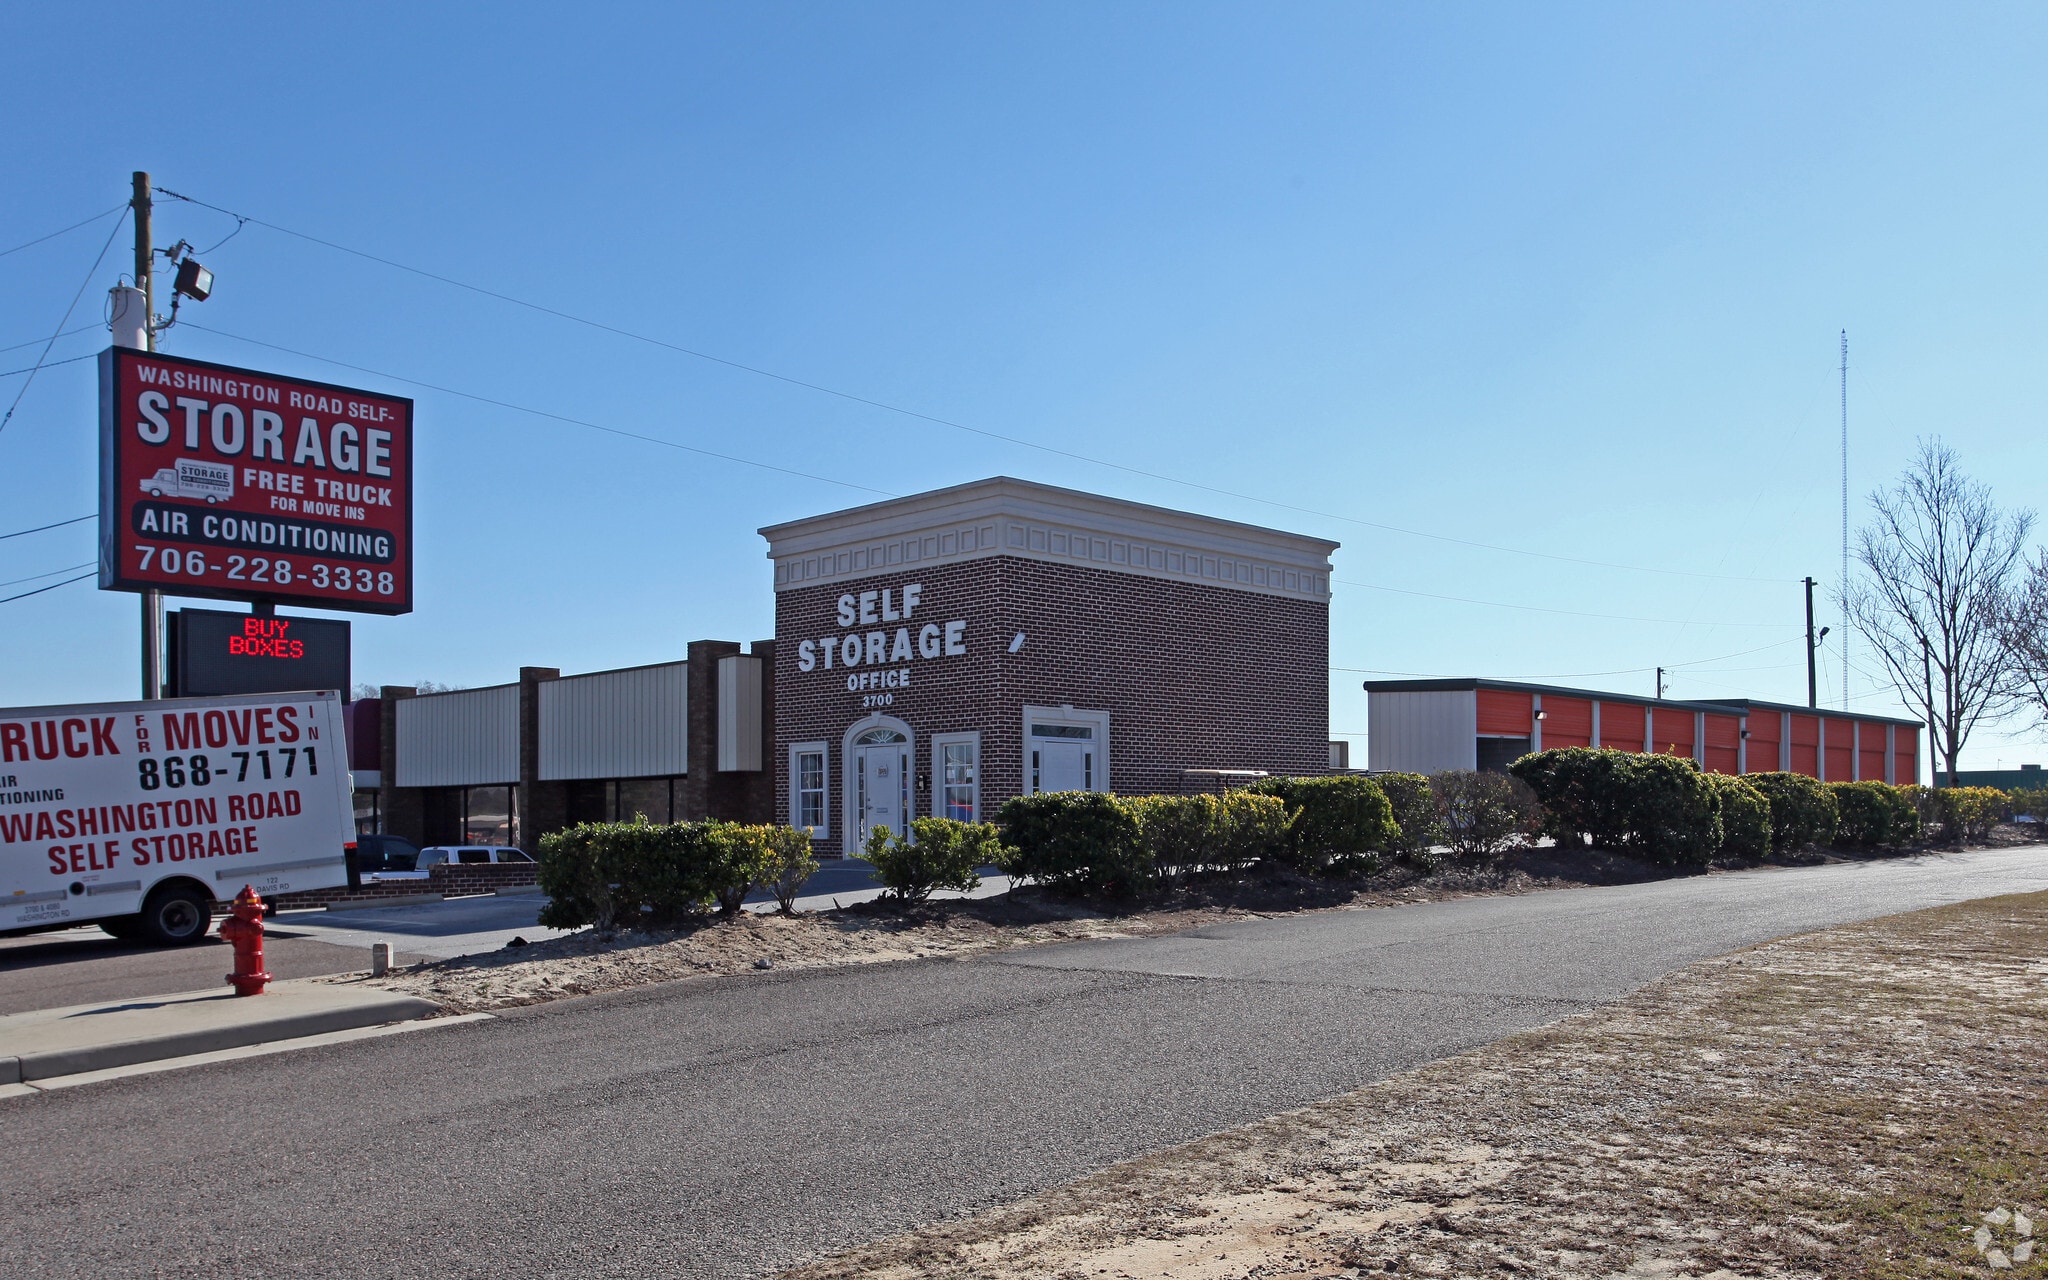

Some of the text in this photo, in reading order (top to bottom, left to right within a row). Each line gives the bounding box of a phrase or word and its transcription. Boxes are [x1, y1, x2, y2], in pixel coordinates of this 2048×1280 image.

[137, 364, 395, 422] WASHINGTON ROAD SELF-
[137, 390, 391, 478] STORAGE
[181, 466, 229, 480] STORAGE
[243, 468, 392, 507] FREE TRUCK
[270, 496, 365, 521] FOR MOVE INS
[141, 508, 389, 558] AIR CONDITIONING
[135, 545, 394, 595] 706-228-3338
[244, 617, 289, 638] BUY
[837, 583, 922, 628] SELF
[229, 635, 304, 659] BOXES
[798, 620, 967, 672] STORAGE
[847, 669, 910, 691] OFFICE
[863, 693, 893, 708] 3700
[0, 705, 319, 763] RUCK FOR MOVES IN
[138, 746, 318, 790] 868-7171
[0, 790, 302, 844] WASHINGTON ROAD
[48, 826, 259, 876] SELF STORAGE
[256, 882, 290, 893] DAVIS RD
